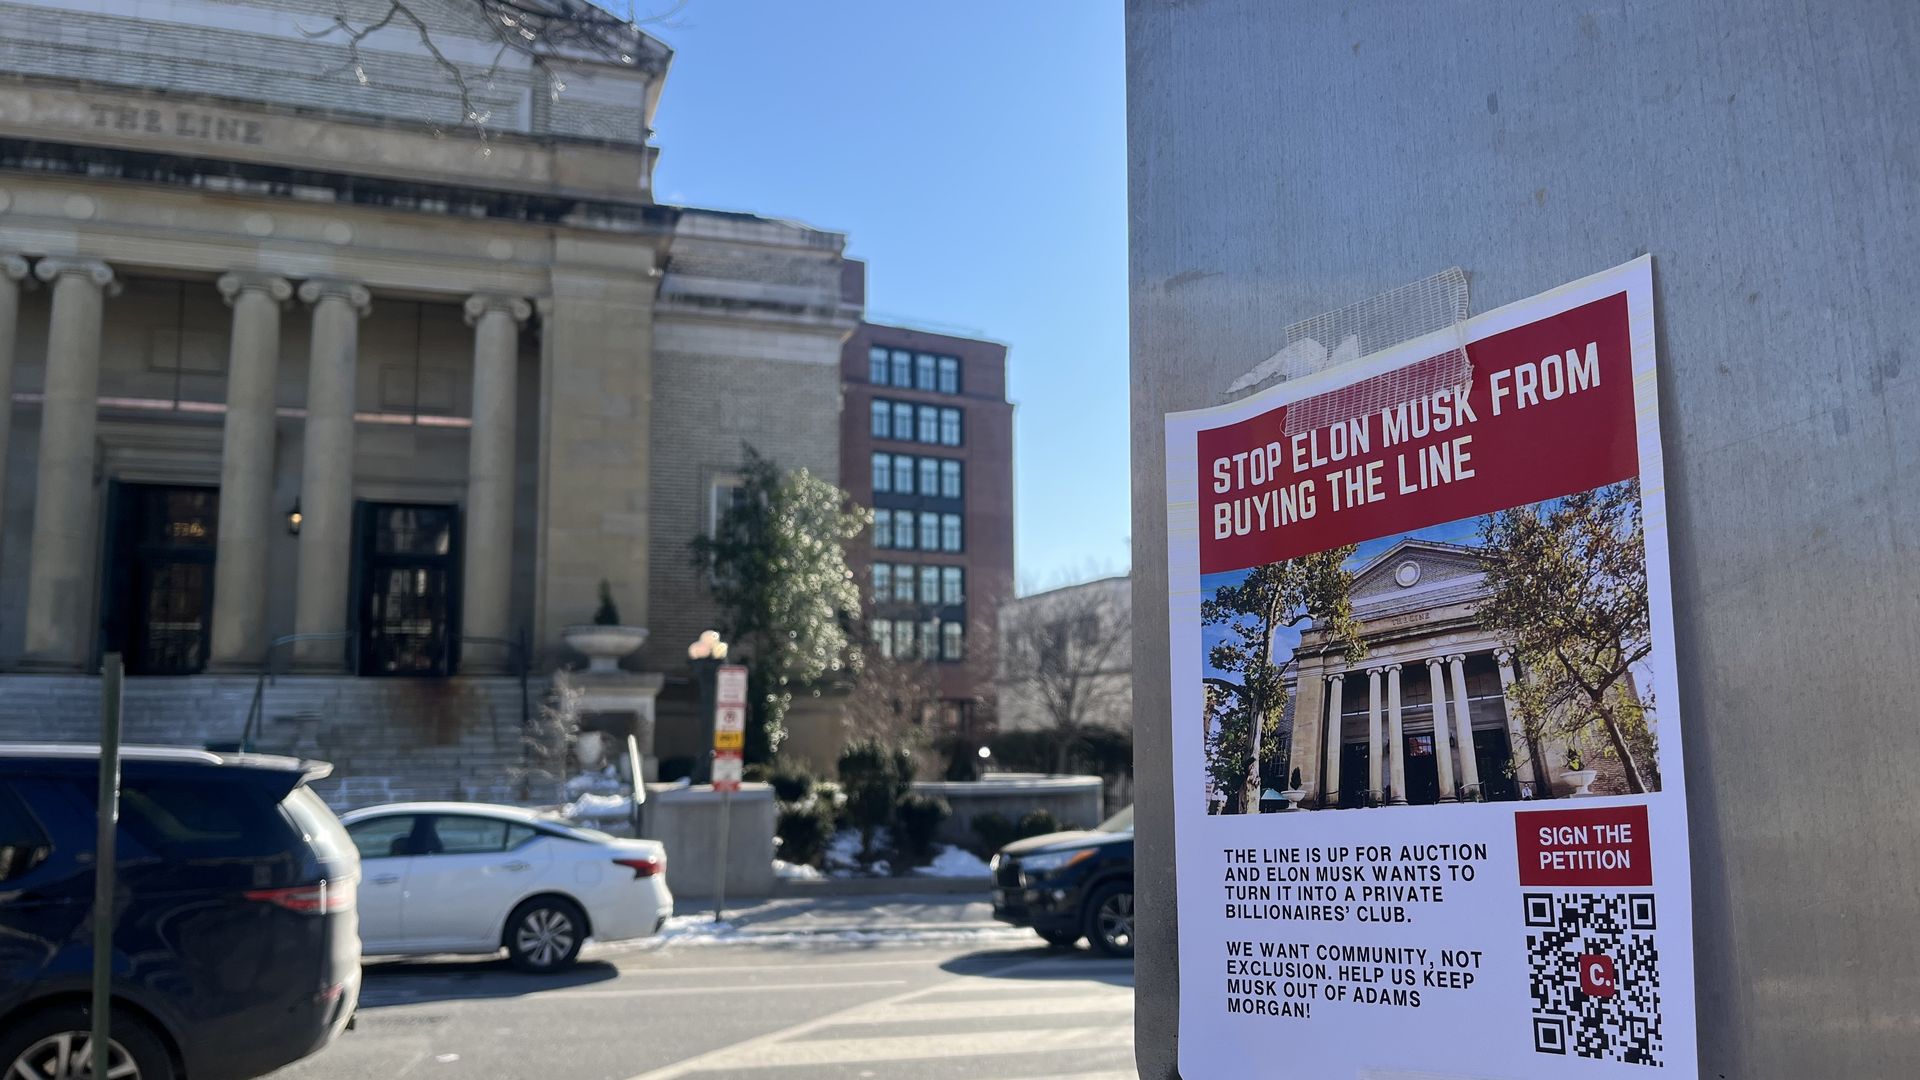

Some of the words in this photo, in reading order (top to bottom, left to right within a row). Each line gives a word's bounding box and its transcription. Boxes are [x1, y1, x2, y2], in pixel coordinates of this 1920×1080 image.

[89, 103, 162, 133] THE
[175, 111, 264, 145] LINE
[1213, 441, 1281, 494] STOP
[1292, 414, 1370, 473] ELON
[1382, 380, 1478, 448] MUSK
[1490, 342, 1600, 416] FROM
[1214, 480, 1316, 540] BUYING
[1327, 460, 1386, 512] THE
[1398, 435, 1475, 496] LINE
[1539, 826, 1588, 846] SIGN
[1593, 824, 1632, 844] THE
[1224, 849, 1257, 863] THE
[1263, 848, 1300, 863] LINE
[1306, 848, 1321, 862] IS
[1328, 847, 1348, 862] UP
[1356, 846, 1391, 862] FOR
[1400, 844, 1487, 861] AUCTION
[1539, 850, 1631, 870] PETITION
[1225, 867, 1260, 882] AND
[1267, 867, 1309, 882] ELON
[1316, 866, 1365, 882] MUSK
[1372, 865, 1440, 882] WANTS
[1448, 865, 1475, 881] TO
[1225, 886, 1270, 900] TURN
[1277, 886, 1291, 901] IT
[1298, 886, 1337, 901] INTO
[1344, 886, 1355, 901] A
[1363, 886, 1443, 902] PRIVATE
[1357, 906, 1412, 923] CLUB.
[1226, 941, 1252, 957] WE
[1260, 943, 1309, 959] WANT
[1316, 944, 1434, 969] COMMUNITY,
[1441, 950, 1482, 969] NOT
[1227, 960, 1332, 980] EXCLUSION.
[1339, 966, 1384, 984] HELP
[1391, 969, 1416, 986] US
[1423, 970, 1474, 989] KEEP
[1227, 979, 1277, 996] MUSK
[1284, 982, 1318, 999] OUT
[1324, 985, 1346, 1001] OF
[1353, 987, 1421, 1008] ADAMS
[1228, 998, 1311, 1018] MORGAN!
